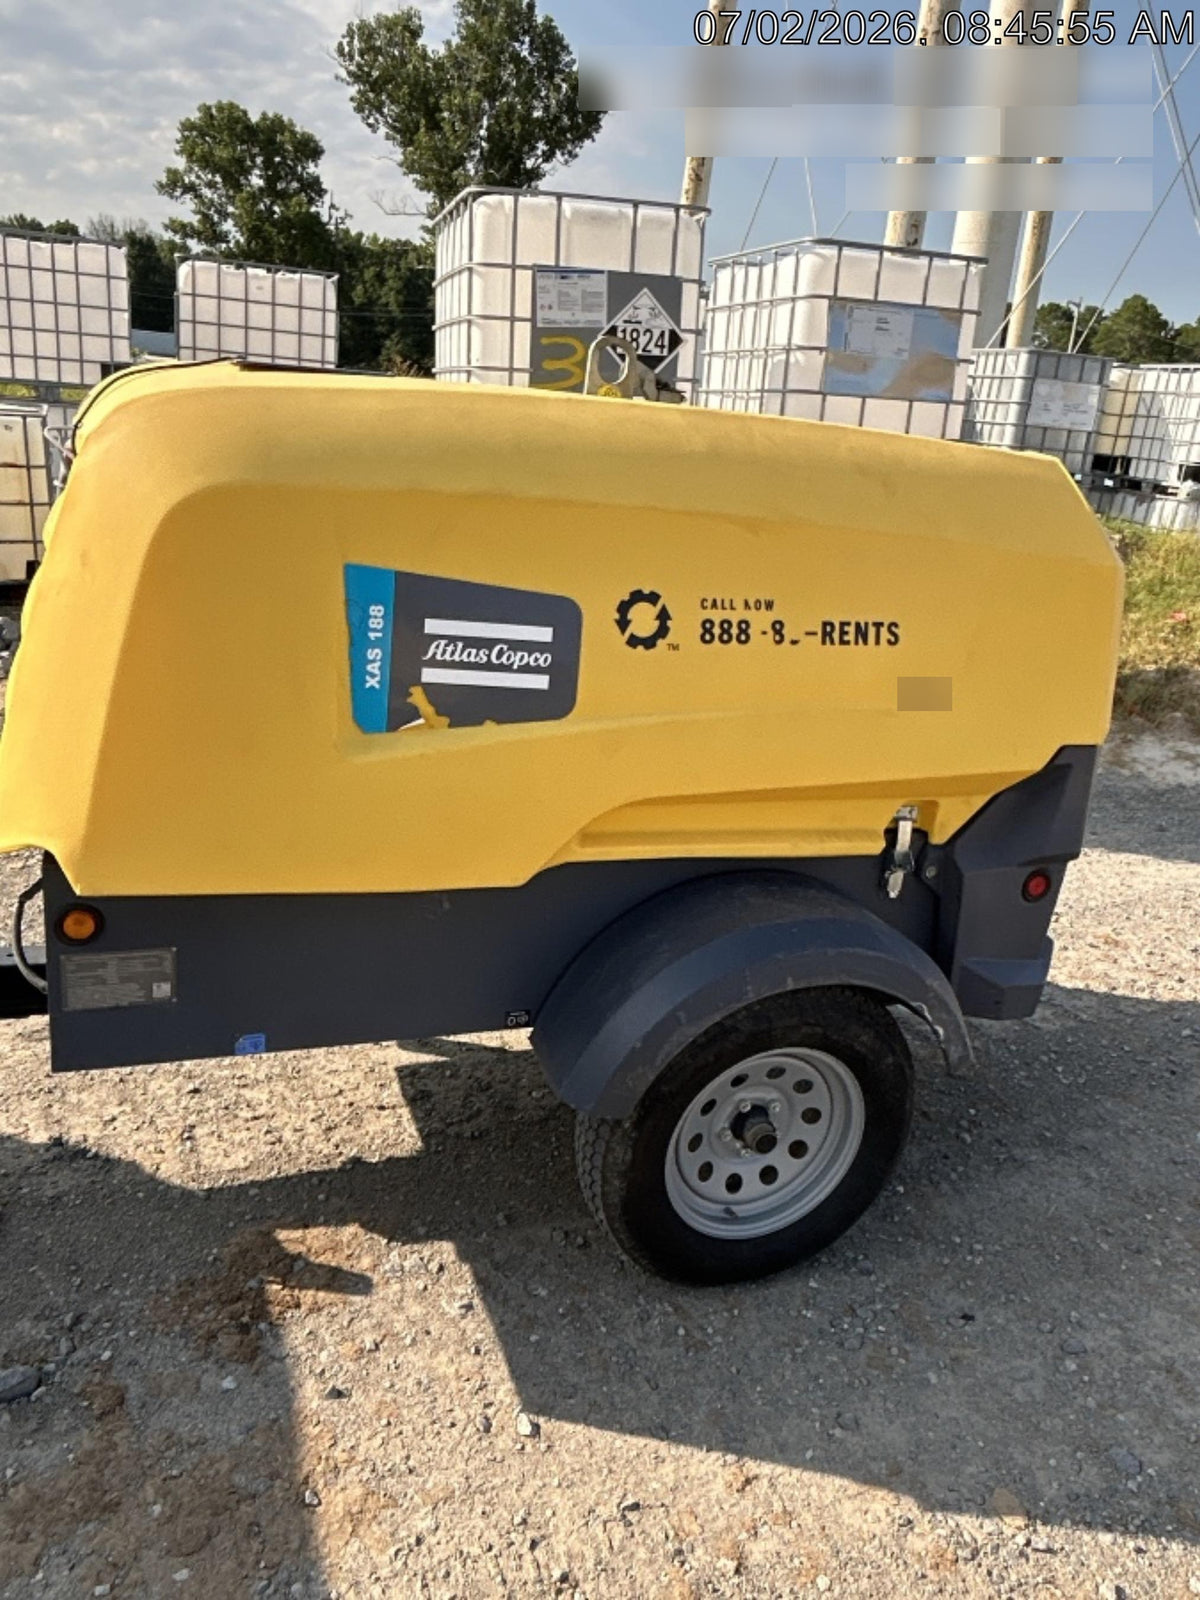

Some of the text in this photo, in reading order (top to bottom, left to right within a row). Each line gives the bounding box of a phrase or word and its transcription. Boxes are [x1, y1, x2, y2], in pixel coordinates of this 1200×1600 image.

[700, 597, 737, 611] CALL
[365, 604, 385, 690] XAS 188
[422, 639, 552, 670] Atlas Copco
